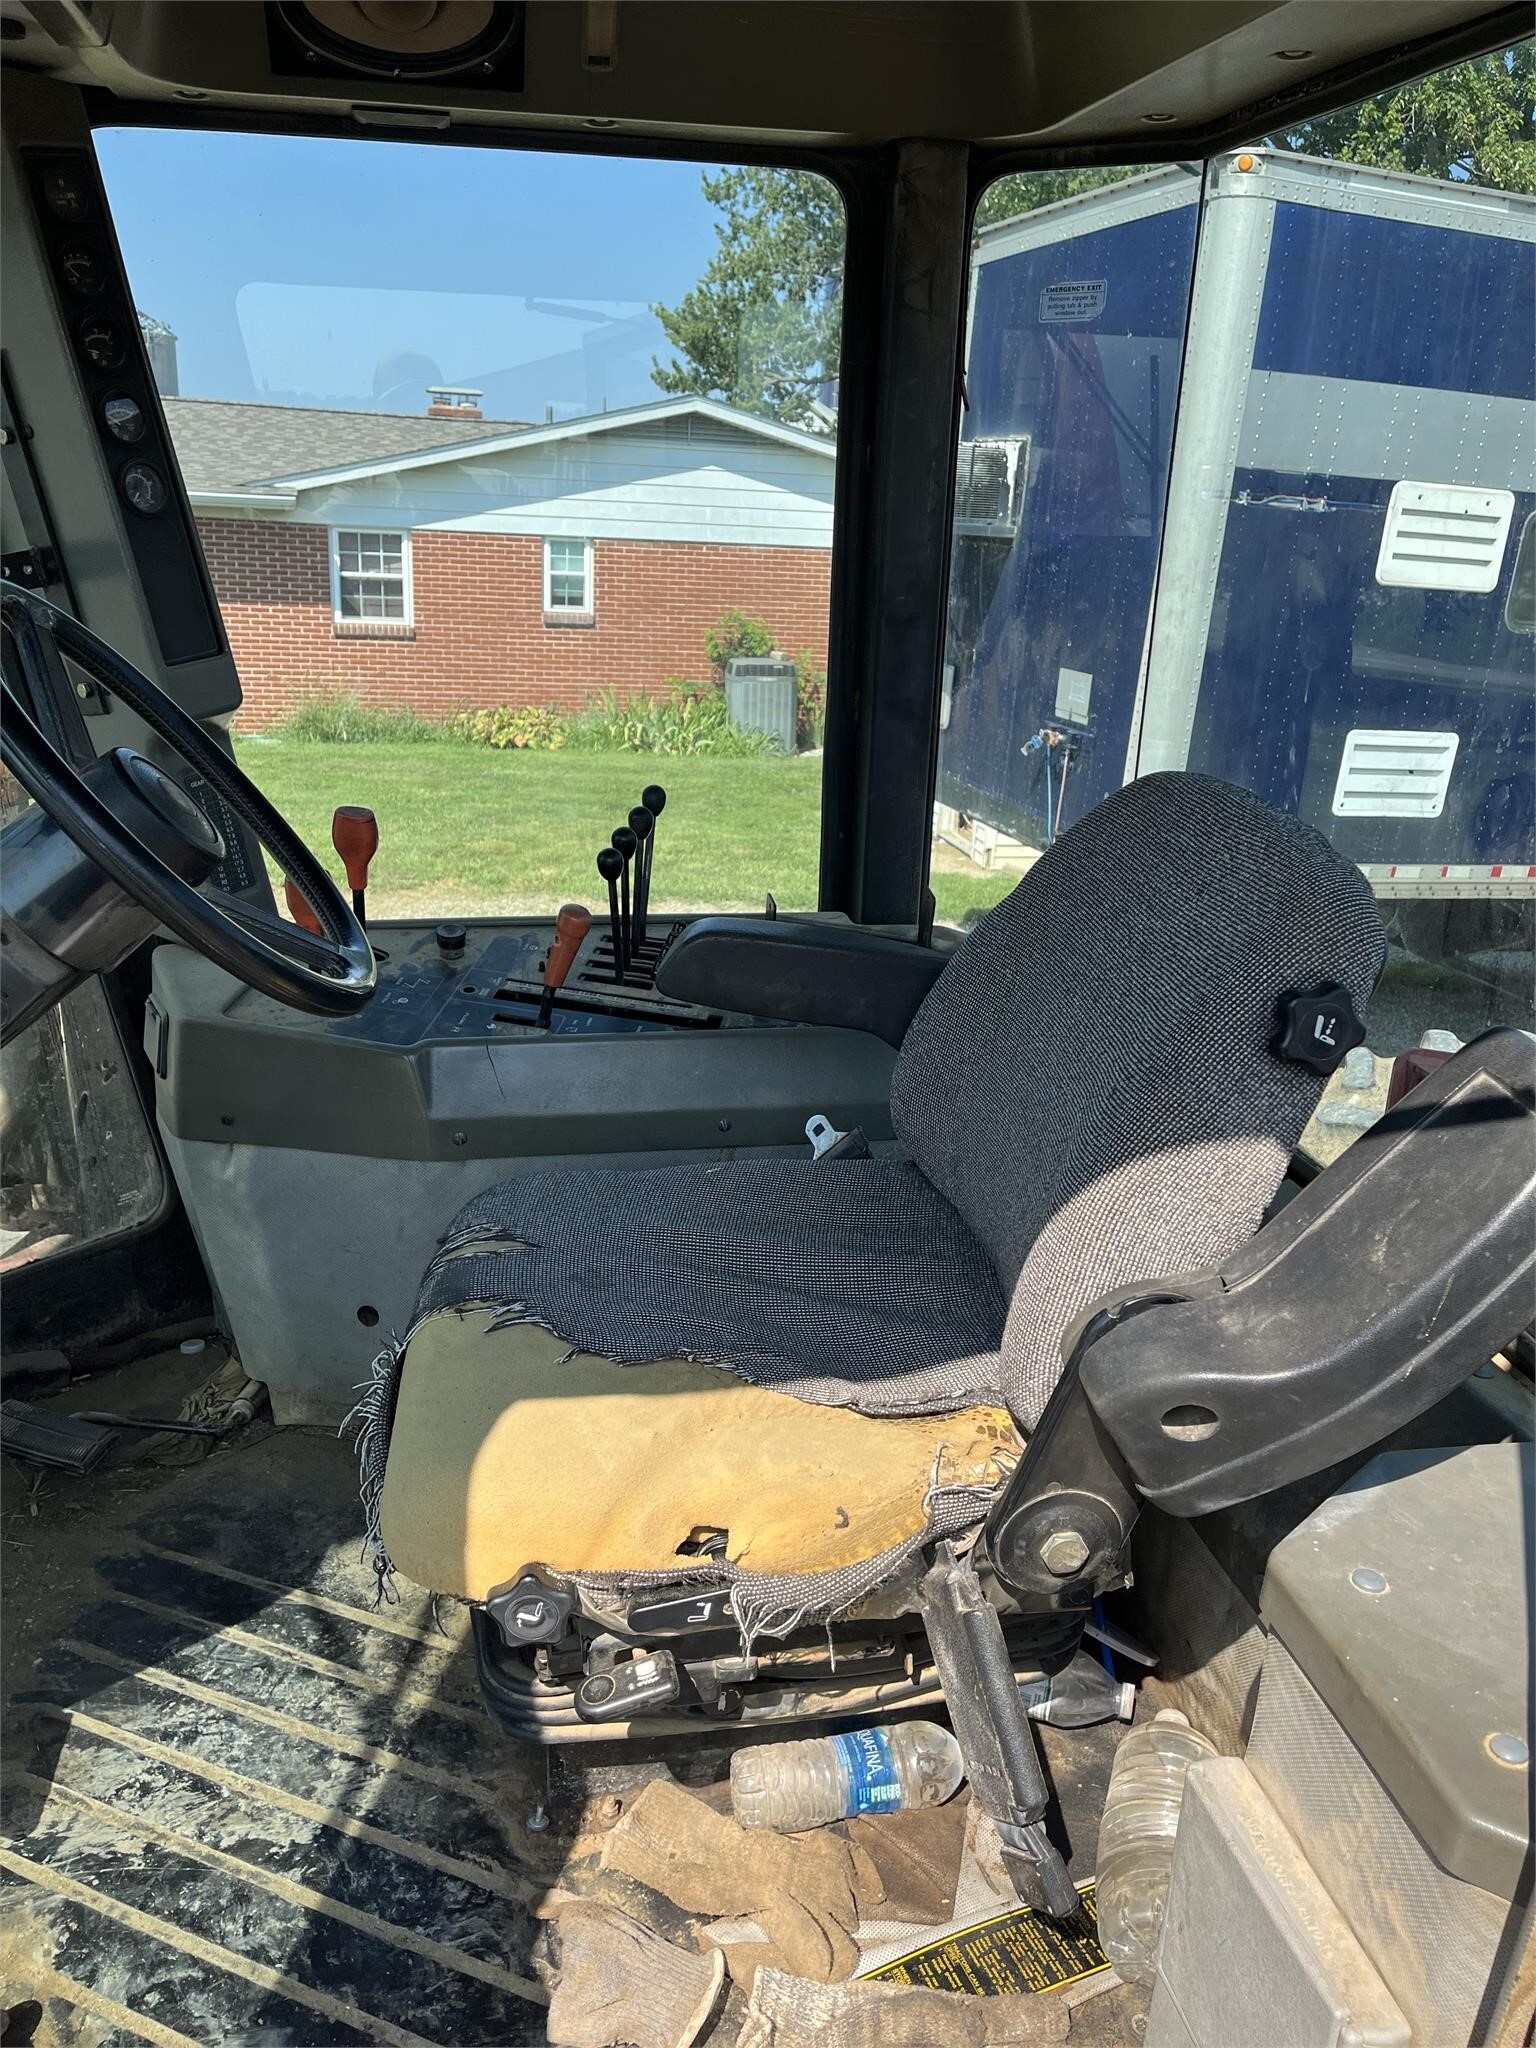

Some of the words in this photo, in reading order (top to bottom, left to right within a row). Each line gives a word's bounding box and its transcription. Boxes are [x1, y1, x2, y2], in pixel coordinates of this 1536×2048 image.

[1046, 285, 1085, 293] EMERGENCY
[857, 1729, 884, 1776] QUAFINA
[897, 1964, 913, 1985] WHEN
[950, 1940, 972, 1974] TRACTORS
[968, 1972, 980, 1987] CAN
